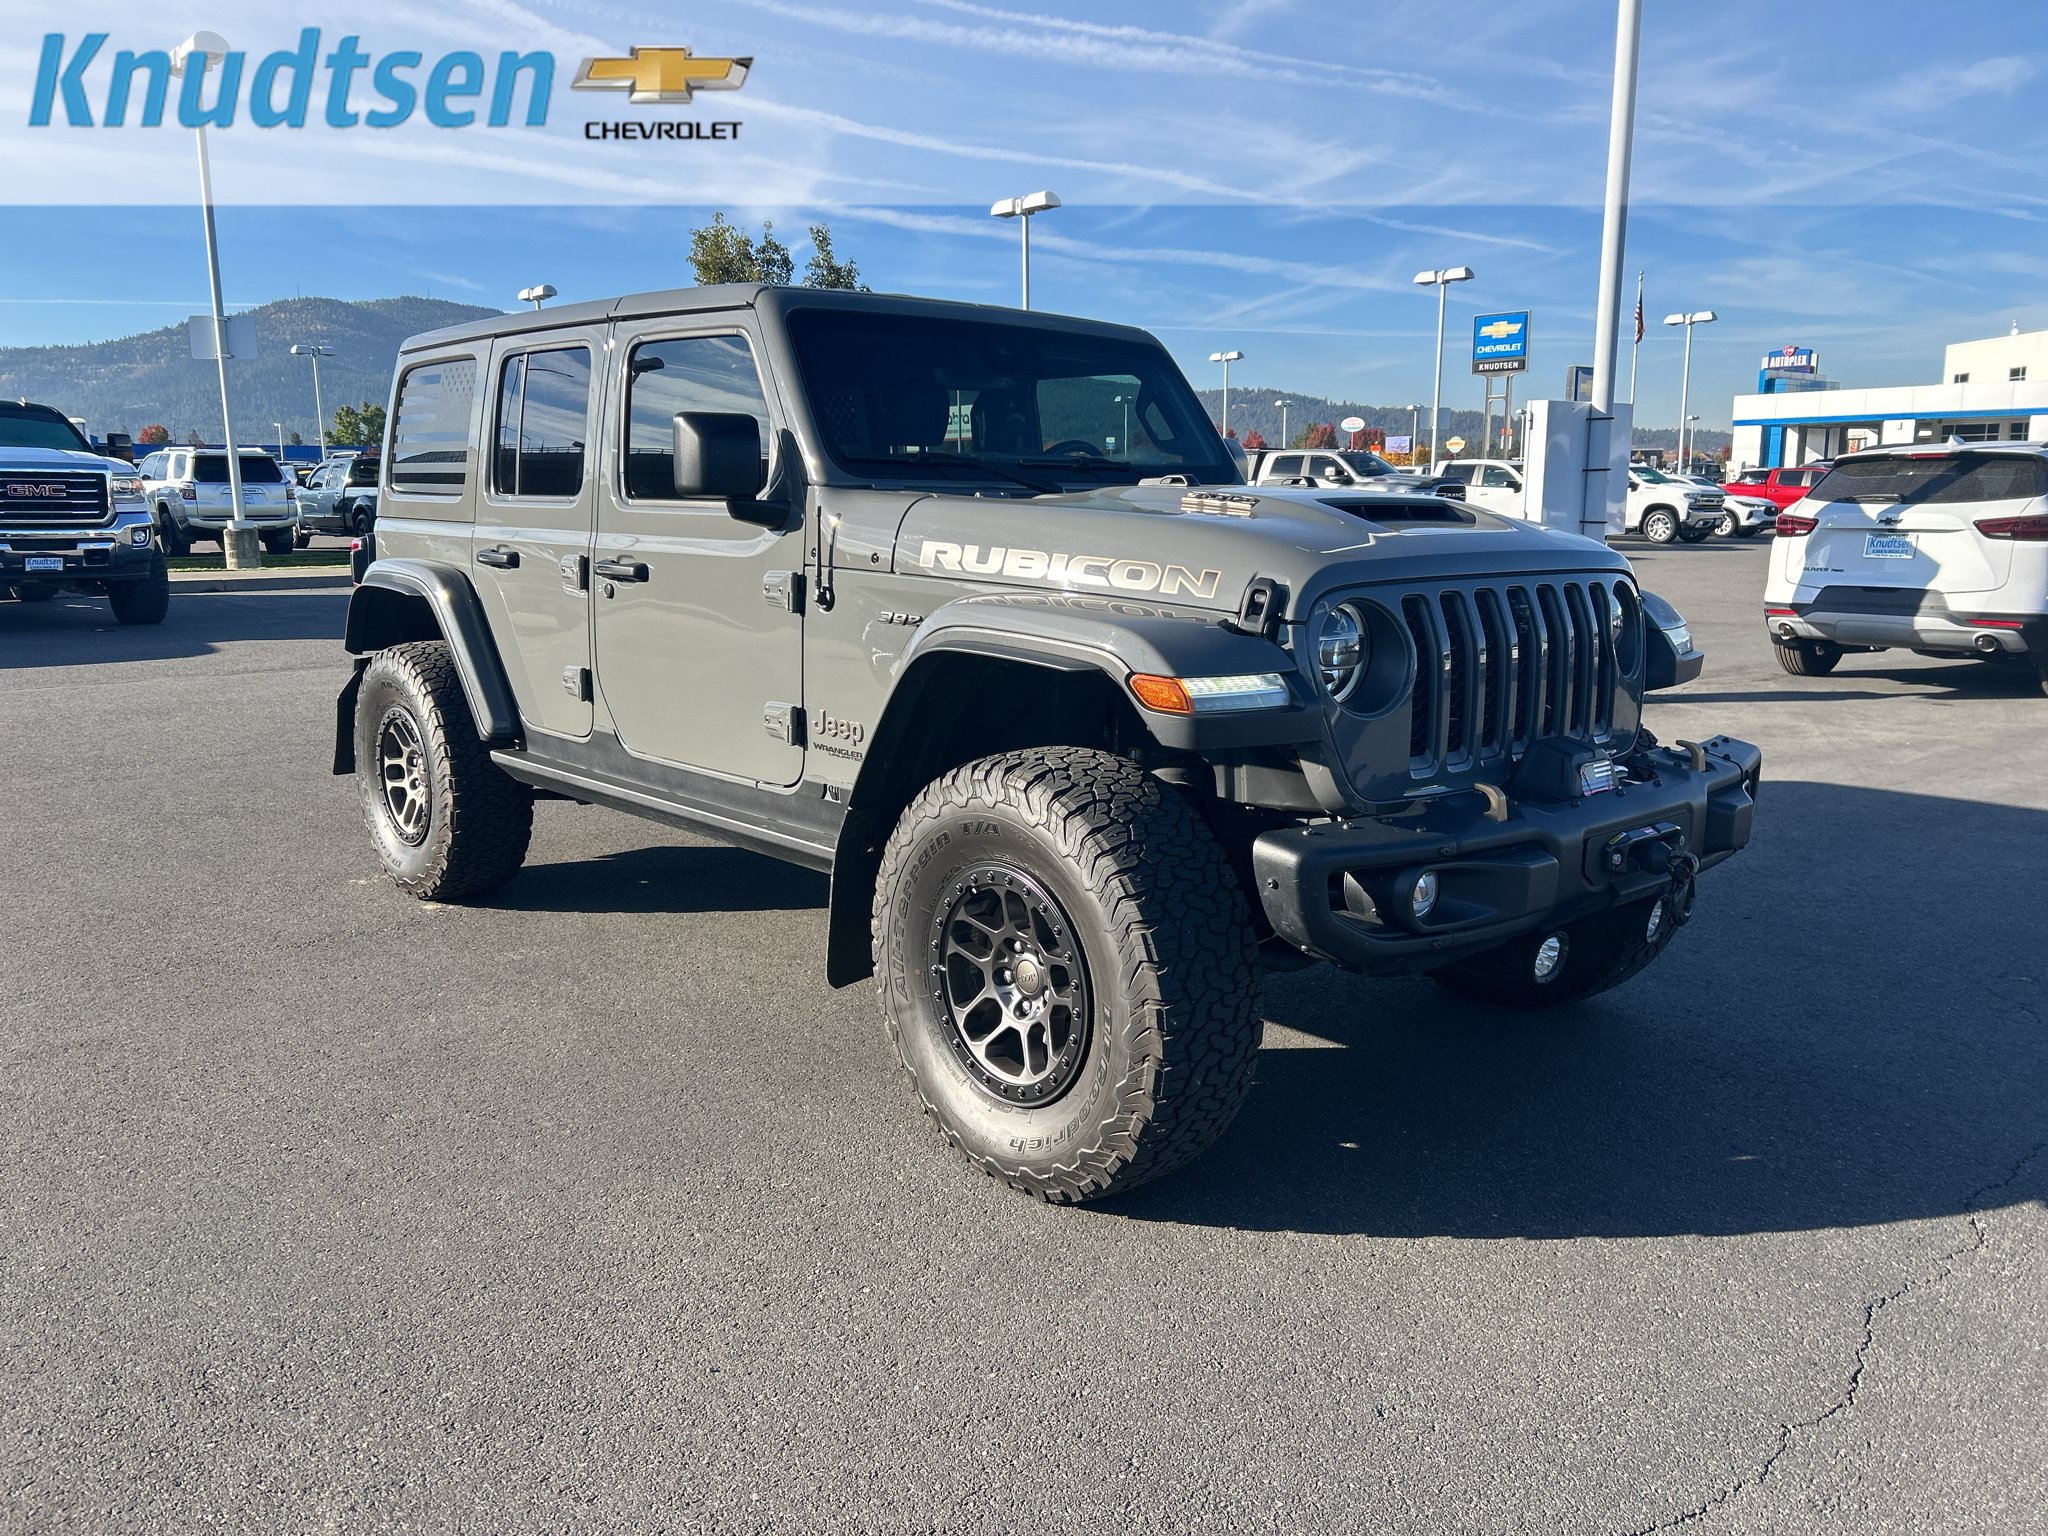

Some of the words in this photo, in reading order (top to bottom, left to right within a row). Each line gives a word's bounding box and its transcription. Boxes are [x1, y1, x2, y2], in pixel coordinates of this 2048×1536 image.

[1477, 343, 1522, 353] CHEVROLET
[1478, 361, 1519, 371] KNUDTSEN
[1769, 355, 1808, 368] AUTOPLEX
[7, 484, 67, 497] GMC
[1869, 537, 1913, 548] Knudtsen
[26, 557, 62, 566] Knudtsen
[919, 540, 1222, 599] RUBICON
[877, 611, 924, 628] 392
[812, 708, 865, 746] Jeep
[813, 742, 863, 758] WRANGLER
[958, 820, 1001, 837] T/A
